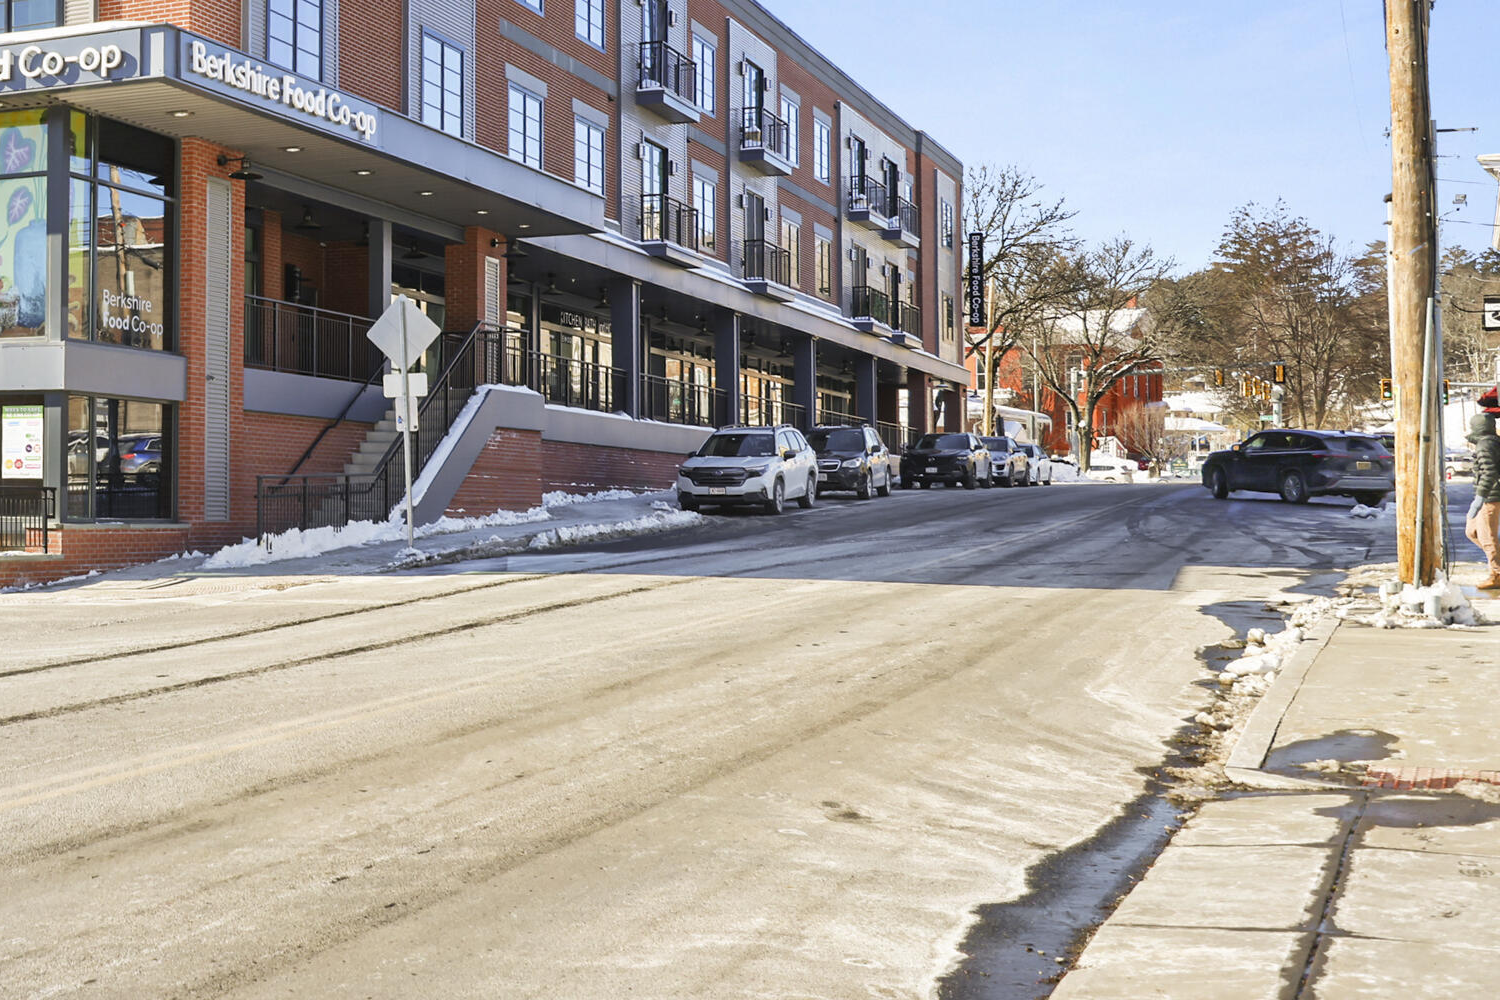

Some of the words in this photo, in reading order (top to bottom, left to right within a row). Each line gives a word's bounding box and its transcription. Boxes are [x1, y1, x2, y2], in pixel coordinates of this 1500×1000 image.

[18, 44, 123, 78] Co-op
[191, 40, 280, 100] Berkshire
[282, 74, 325, 117] Food
[327, 93, 376, 140] Co-op
[971, 235, 980, 273] Berkshire
[972, 275, 981, 296] Food
[103, 289, 152, 312] Berkshire
[972, 297, 981, 323] Co-op
[103, 311, 130, 331] Food
[131, 315, 164, 340] Co-op
